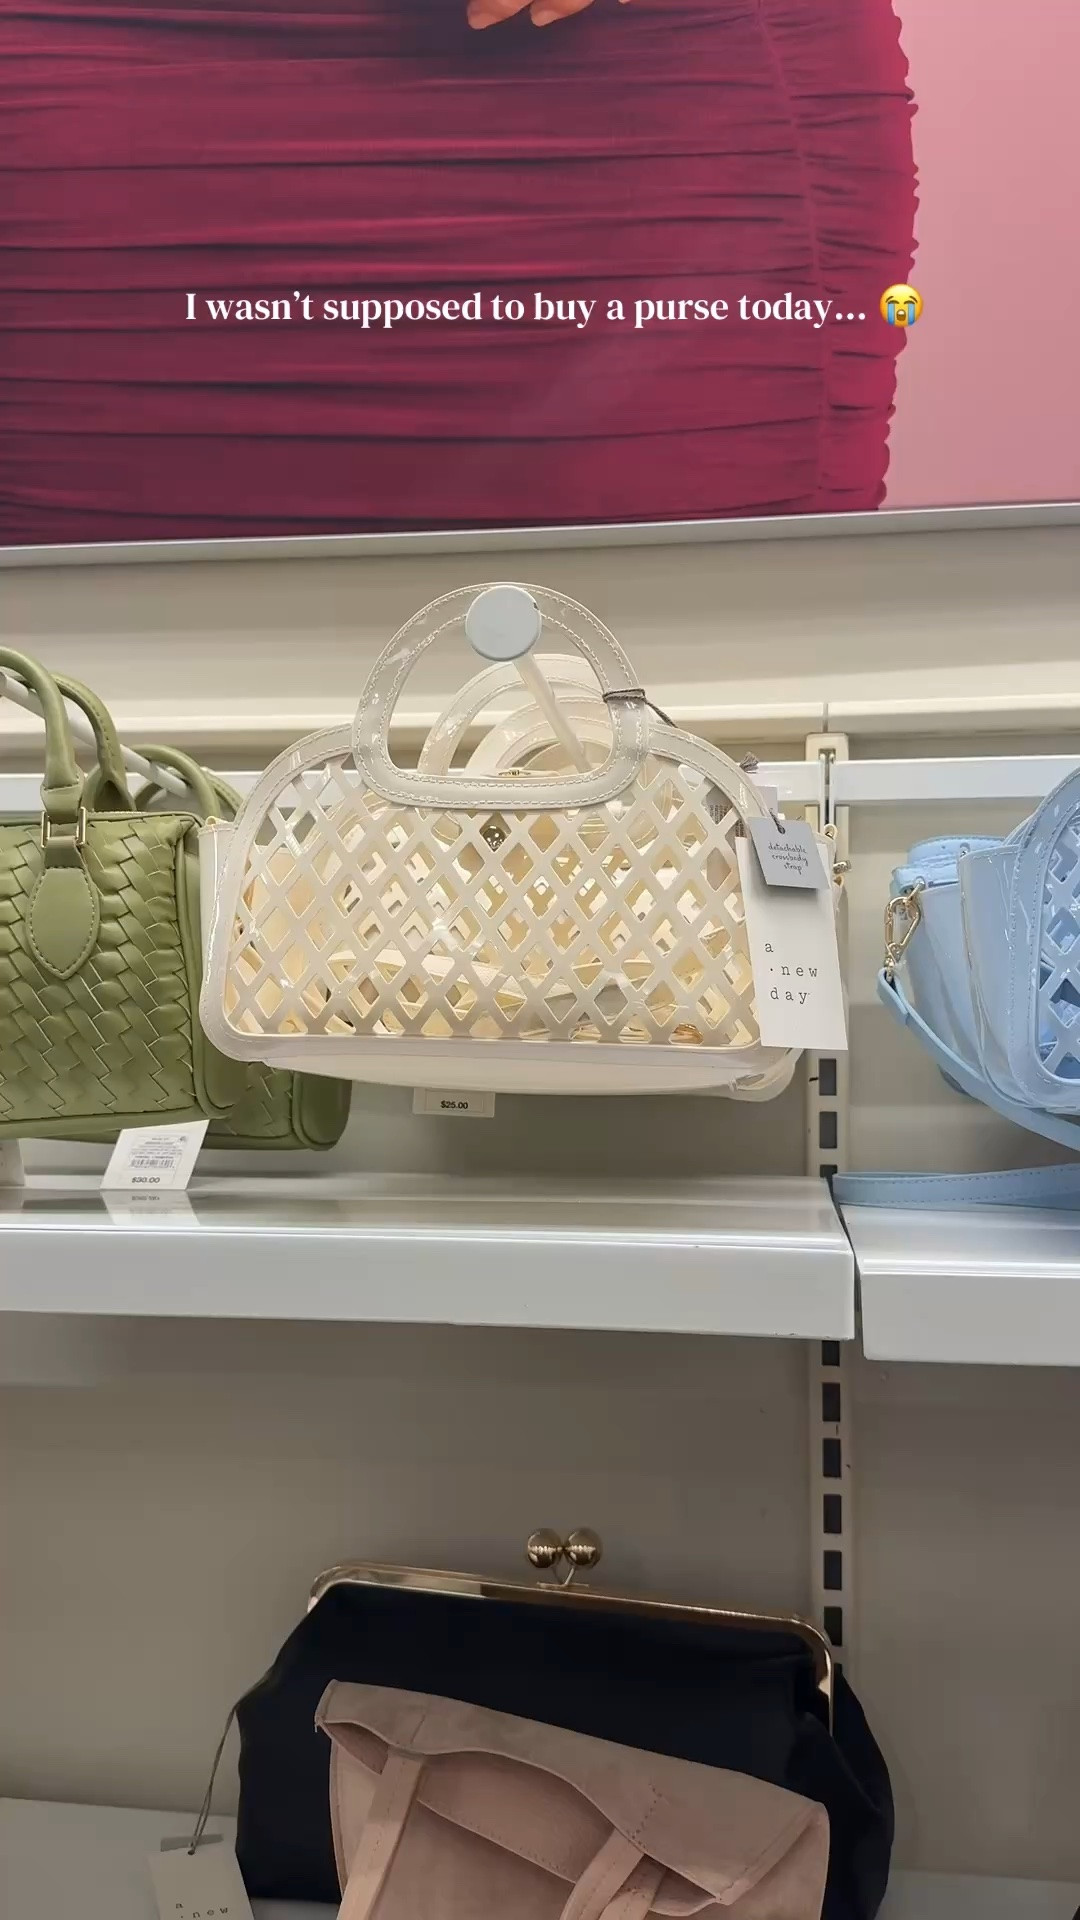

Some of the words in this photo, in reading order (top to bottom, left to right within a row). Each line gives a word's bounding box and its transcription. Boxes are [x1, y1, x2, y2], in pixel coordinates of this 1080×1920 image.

[768, 841, 807, 855] detachable
[772, 853, 809, 867] crossbody
[783, 862, 803, 876] strap
[764, 943, 775, 954] a
[769, 987, 808, 1005] day
[440, 1099, 469, 1110] $25.00
[131, 1176, 161, 1184] $30.00
